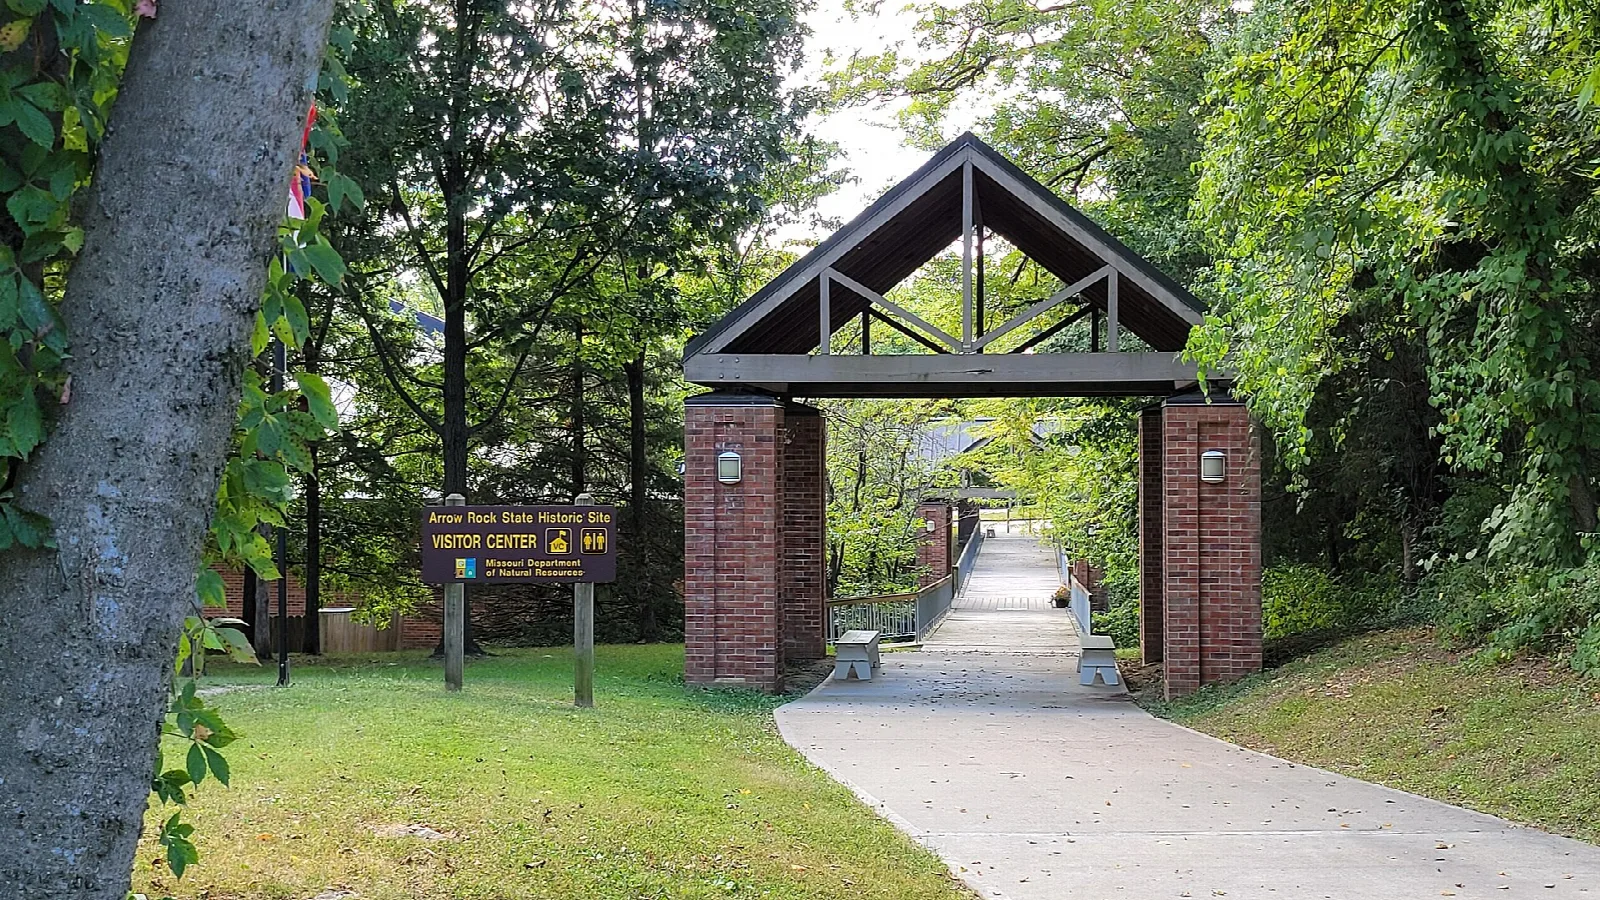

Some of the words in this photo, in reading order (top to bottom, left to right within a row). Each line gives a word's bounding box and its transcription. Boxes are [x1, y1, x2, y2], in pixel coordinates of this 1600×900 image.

[428, 511, 463, 524] Arrow
[467, 511, 497, 524] Rock
[501, 511, 534, 524] State
[538, 511, 583, 524] Historic
[587, 511, 611, 524] Site
[432, 534, 481, 549] VISITOR
[486, 534, 537, 549] CENTER
[485, 558, 524, 567] Missouri
[527, 558, 581, 569] Department
[485, 568, 495, 577] of
[499, 568, 532, 577] Natural
[535, 568, 584, 577] Resources
